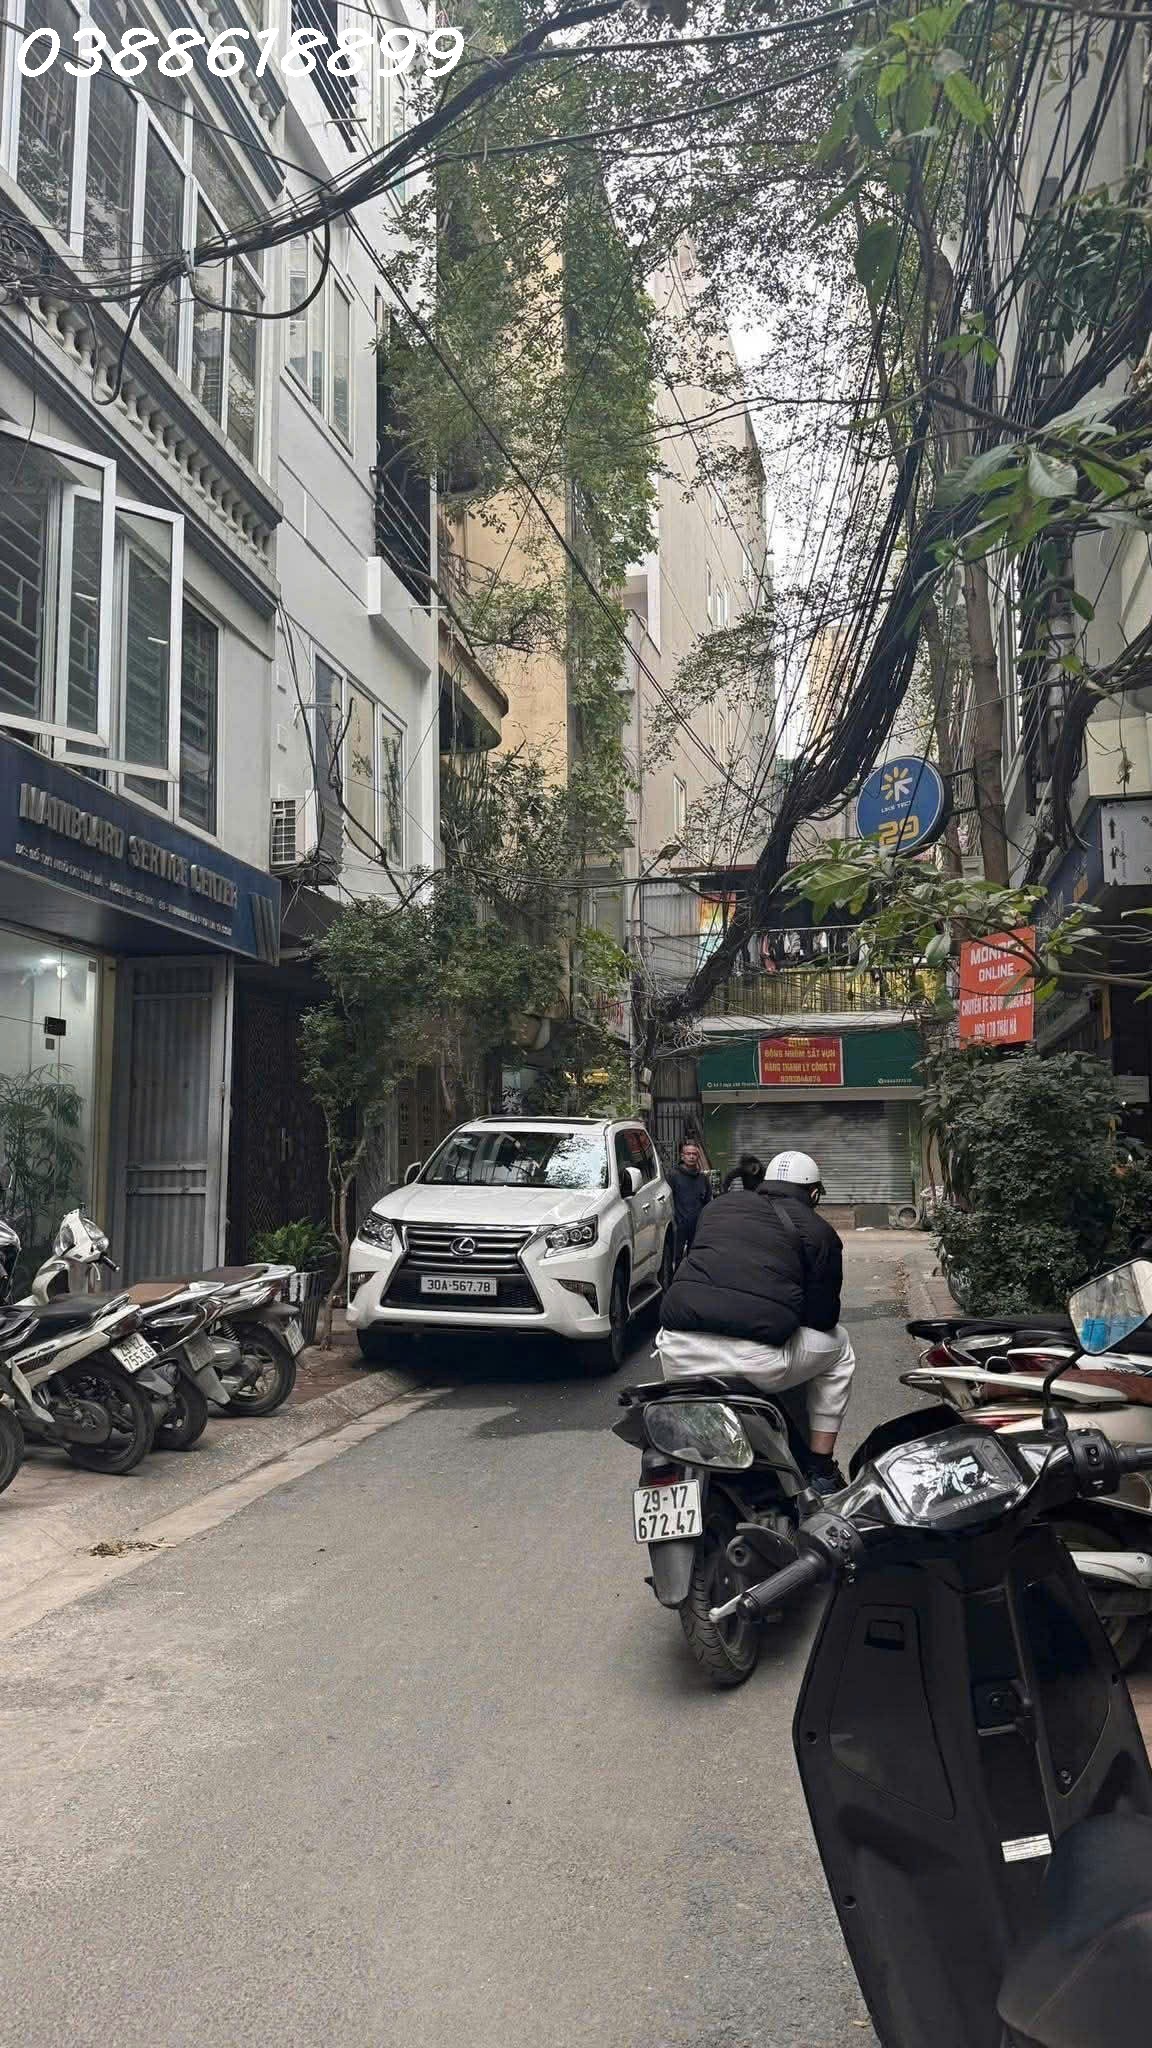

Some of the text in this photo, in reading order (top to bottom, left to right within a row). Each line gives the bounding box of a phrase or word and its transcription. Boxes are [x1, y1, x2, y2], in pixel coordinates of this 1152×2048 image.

[878, 815, 919, 846] 29
[20, 783, 125, 859] MAINBOARD
[128, 835, 188, 888] SERVICE
[190, 864, 239, 910] CENTER
[979, 962, 1015, 982] ONLINE
[427, 1279, 491, 1293] 30A-567.78
[642, 1485, 689, 1513] 29-Y7
[638, 1509, 696, 1539] 672.47
